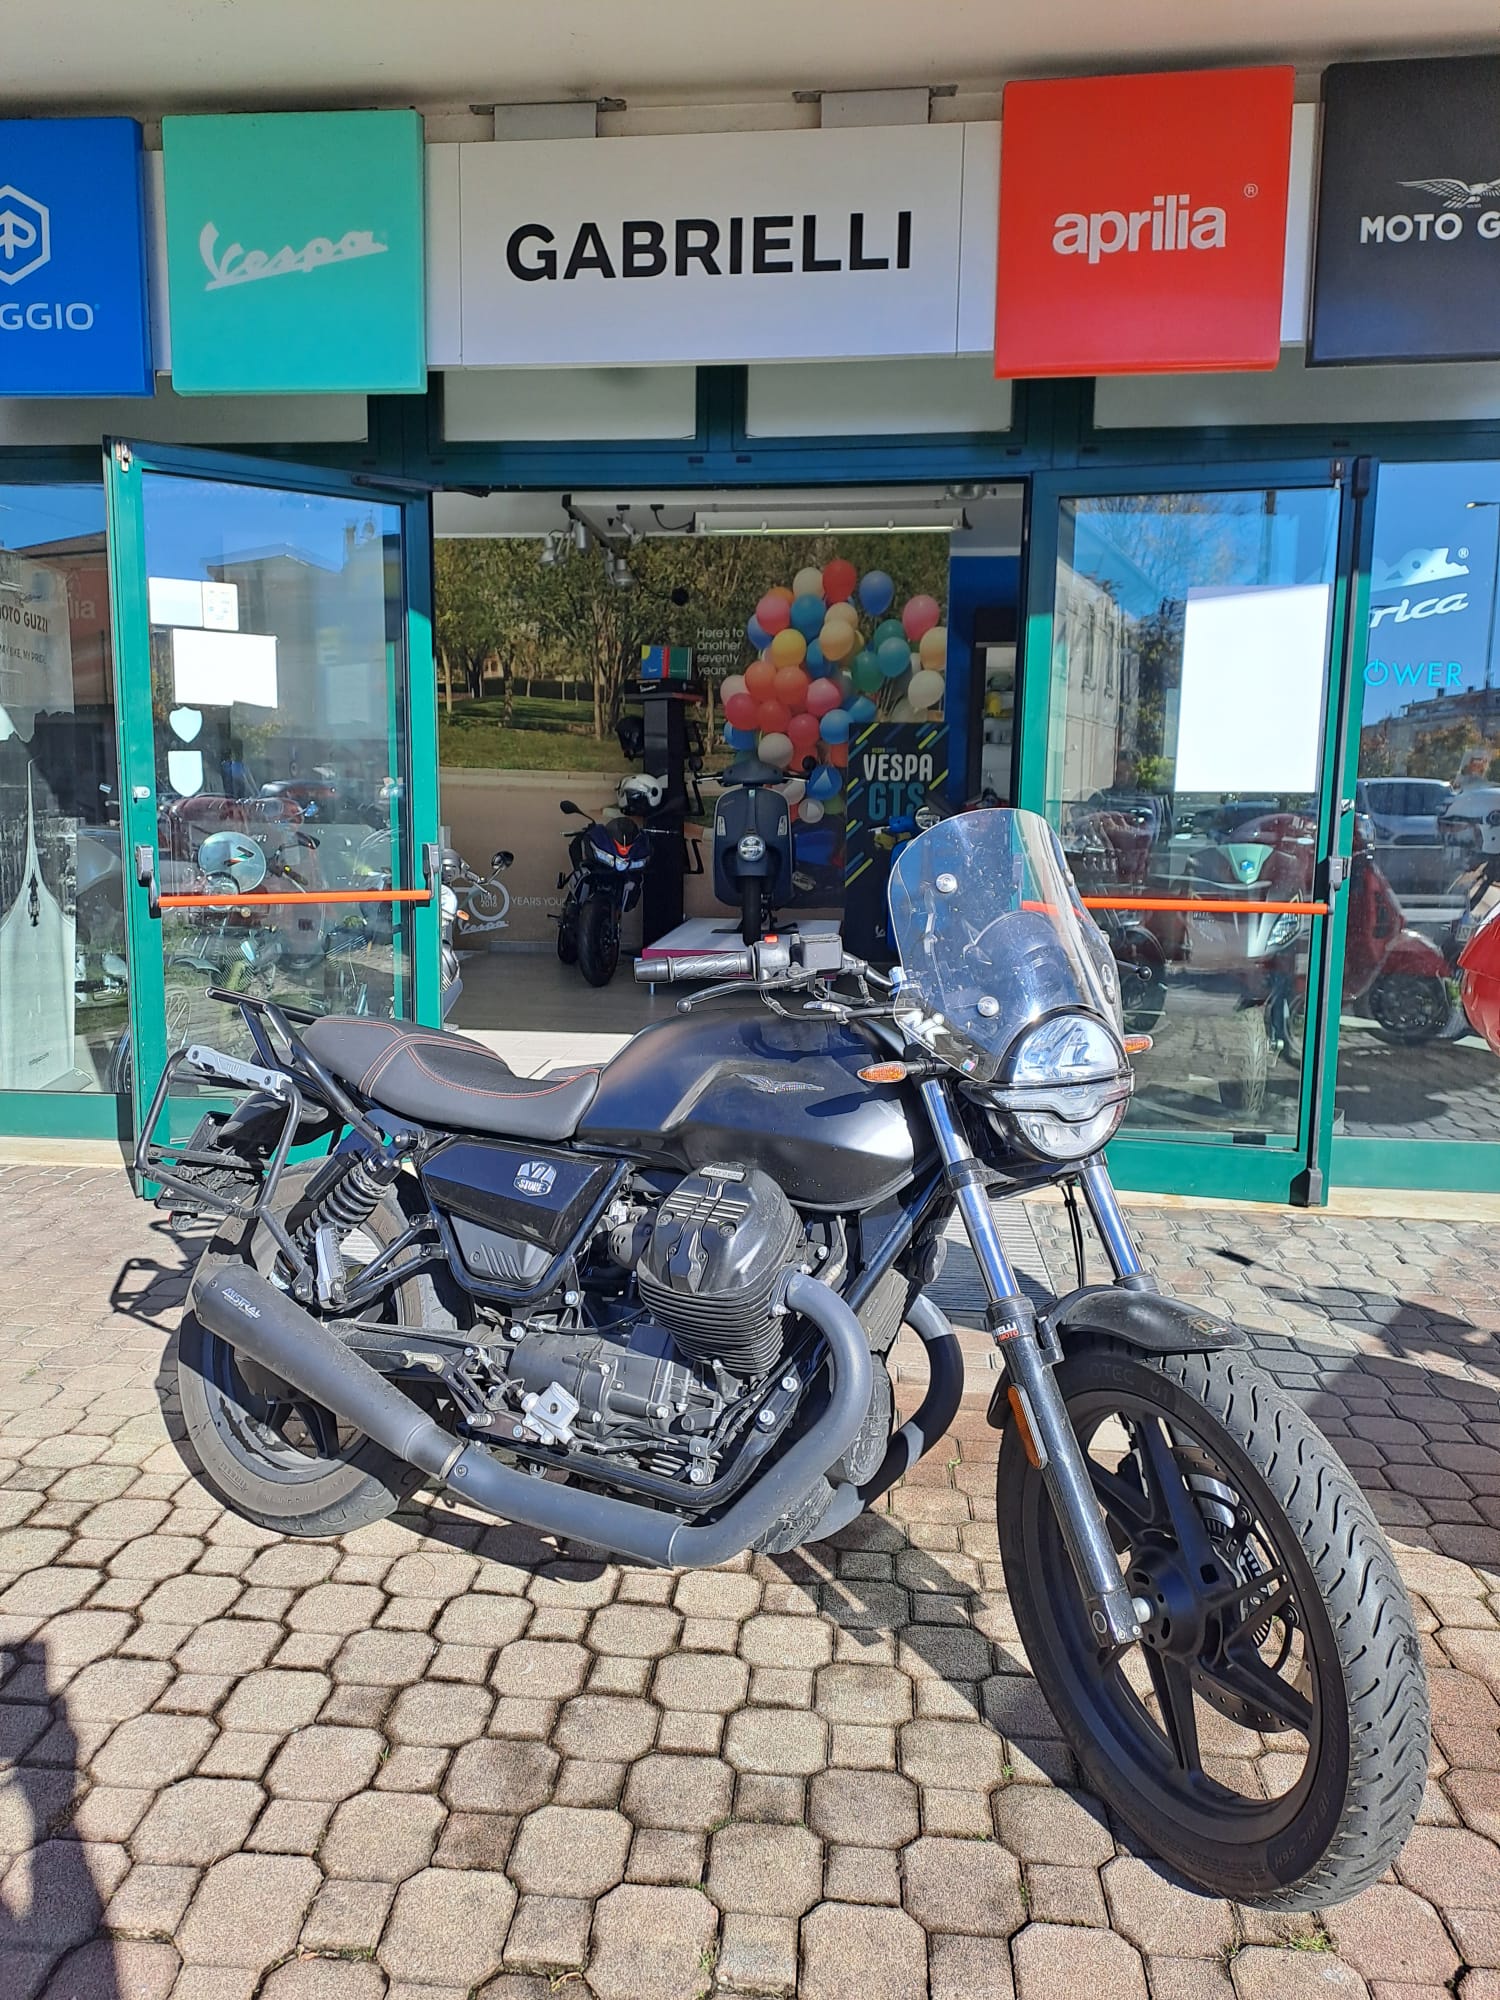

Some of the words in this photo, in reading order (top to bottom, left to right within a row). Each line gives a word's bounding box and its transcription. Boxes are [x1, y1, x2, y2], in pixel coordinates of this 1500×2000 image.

[1052, 194, 1227, 265] aprilia
[1360, 212, 1463, 244] MOTO
[199, 221, 389, 291] Vespa
[506, 211, 912, 282] GABRIELLI
[0, 604, 21, 625] OTO
[23, 611, 48, 633] GUZZI
[697, 627, 730, 638] Here's
[732, 627, 744, 638] to
[697, 640, 741, 651] another
[697, 653, 740, 664] seventy
[697, 667, 727, 677] years
[863, 754, 933, 782] VESPA
[868, 782, 925, 820] GTS
[511, 896, 541, 906] YEARS
